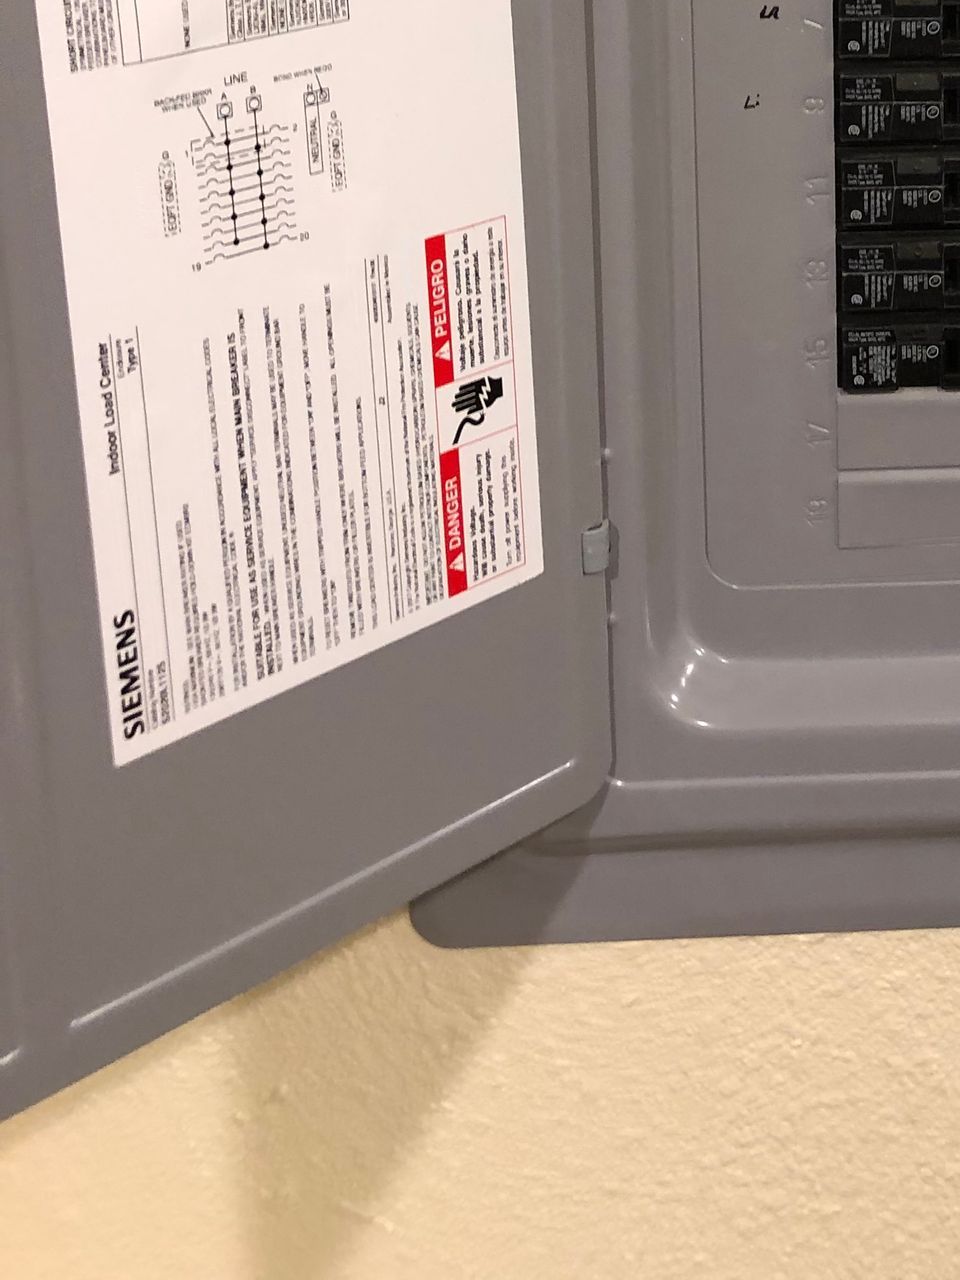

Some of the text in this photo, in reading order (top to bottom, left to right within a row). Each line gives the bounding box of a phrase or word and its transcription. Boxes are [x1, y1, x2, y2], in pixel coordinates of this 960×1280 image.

[221, 92, 227, 101] A
[223, 71, 248, 87] LINE
[250, 85, 257, 94] B
[308, 117, 319, 163] NEUTRAL
[430, 257, 447, 338] PELIGRO
[125, 345, 138, 373] Type
[804, 338, 830, 369] 15
[96, 341, 119, 475] Indoor Load Center
[444, 475, 461, 551] DANGER
[113, 607, 145, 740] SIEMENS
